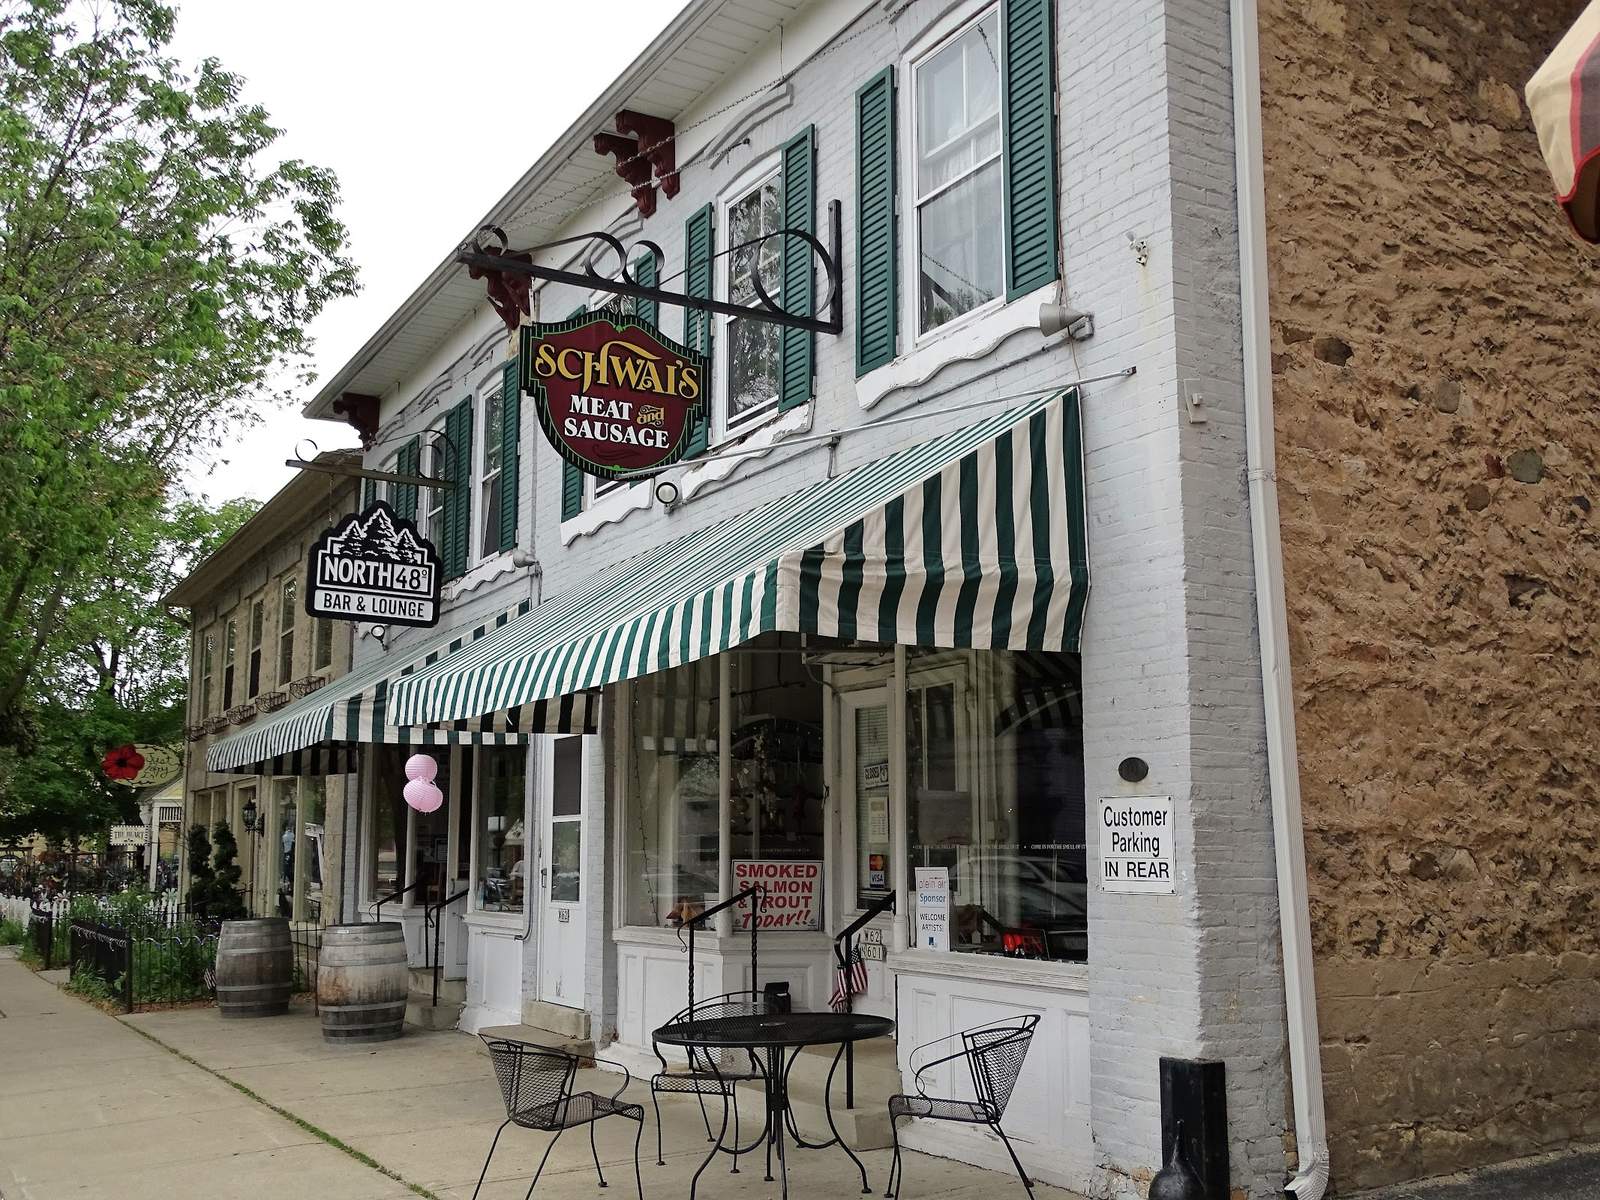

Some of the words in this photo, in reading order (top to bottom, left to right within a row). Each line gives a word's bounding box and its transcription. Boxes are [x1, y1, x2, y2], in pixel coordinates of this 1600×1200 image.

[534, 340, 699, 399] SCHWAI'S
[569, 395, 633, 420] MEAT
[564, 418, 670, 449] SAUSAGE
[323, 592, 351, 611] BAR
[356, 596, 366, 612] &
[372, 597, 425, 618] LOUNGE
[1103, 806, 1168, 827] Customer
[1112, 832, 1160, 858] Parking
[736, 864, 818, 878] SMOKED
[871, 873, 883, 882] VISA
[1105, 861, 1119, 877] IN
[1127, 862, 1170, 878] REAR
[740, 881, 813, 893] SALMON
[919, 893, 946, 904] Sponsor
[920, 913, 946, 921] WELCOME
